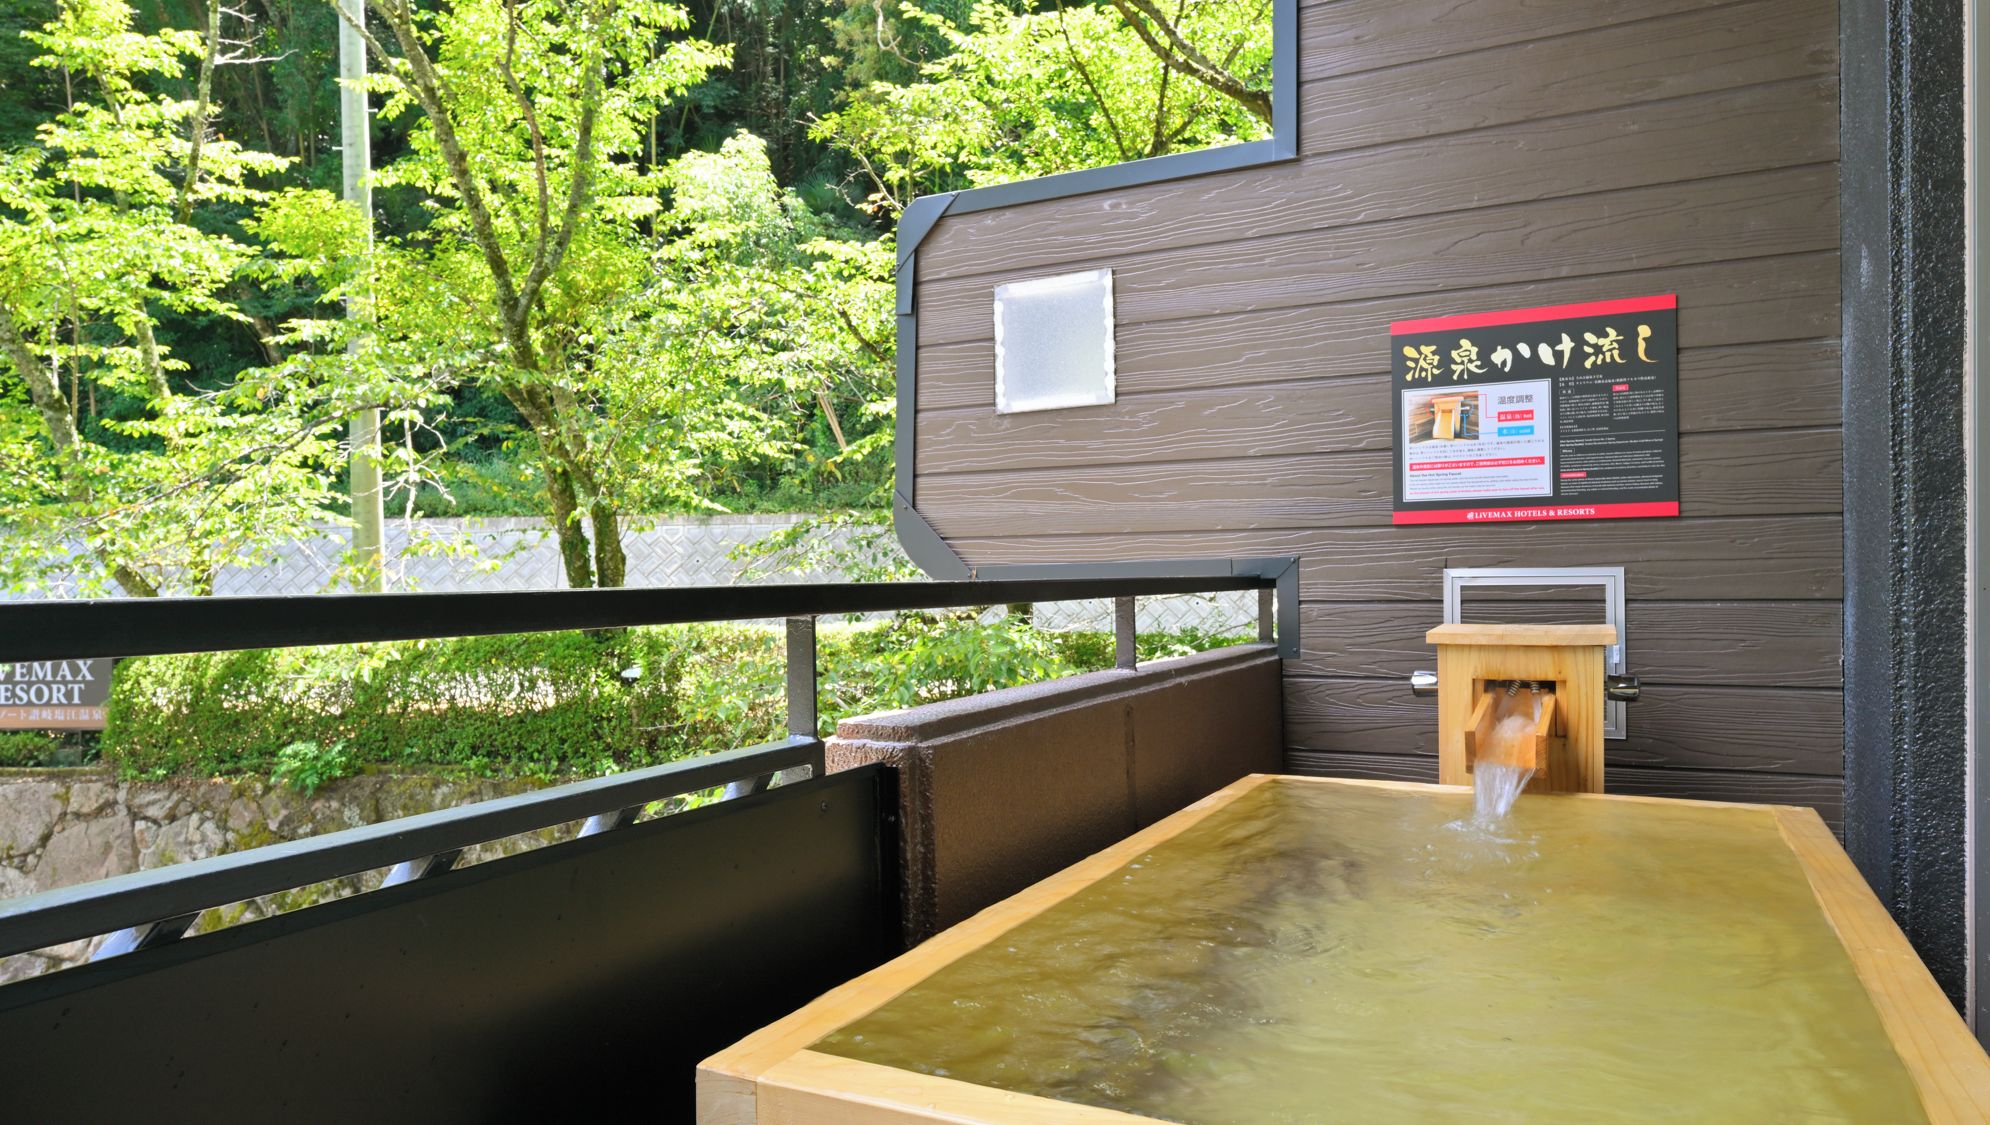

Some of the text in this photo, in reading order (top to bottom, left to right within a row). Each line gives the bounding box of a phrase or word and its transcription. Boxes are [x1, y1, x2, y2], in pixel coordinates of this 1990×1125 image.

[1403, 324, 1660, 382] 源泉かけ流し
[1498, 394, 1534, 405] 温度調整
[1514, 509, 1548, 518] HOTELS
[1557, 508, 1596, 516] RESORTS
